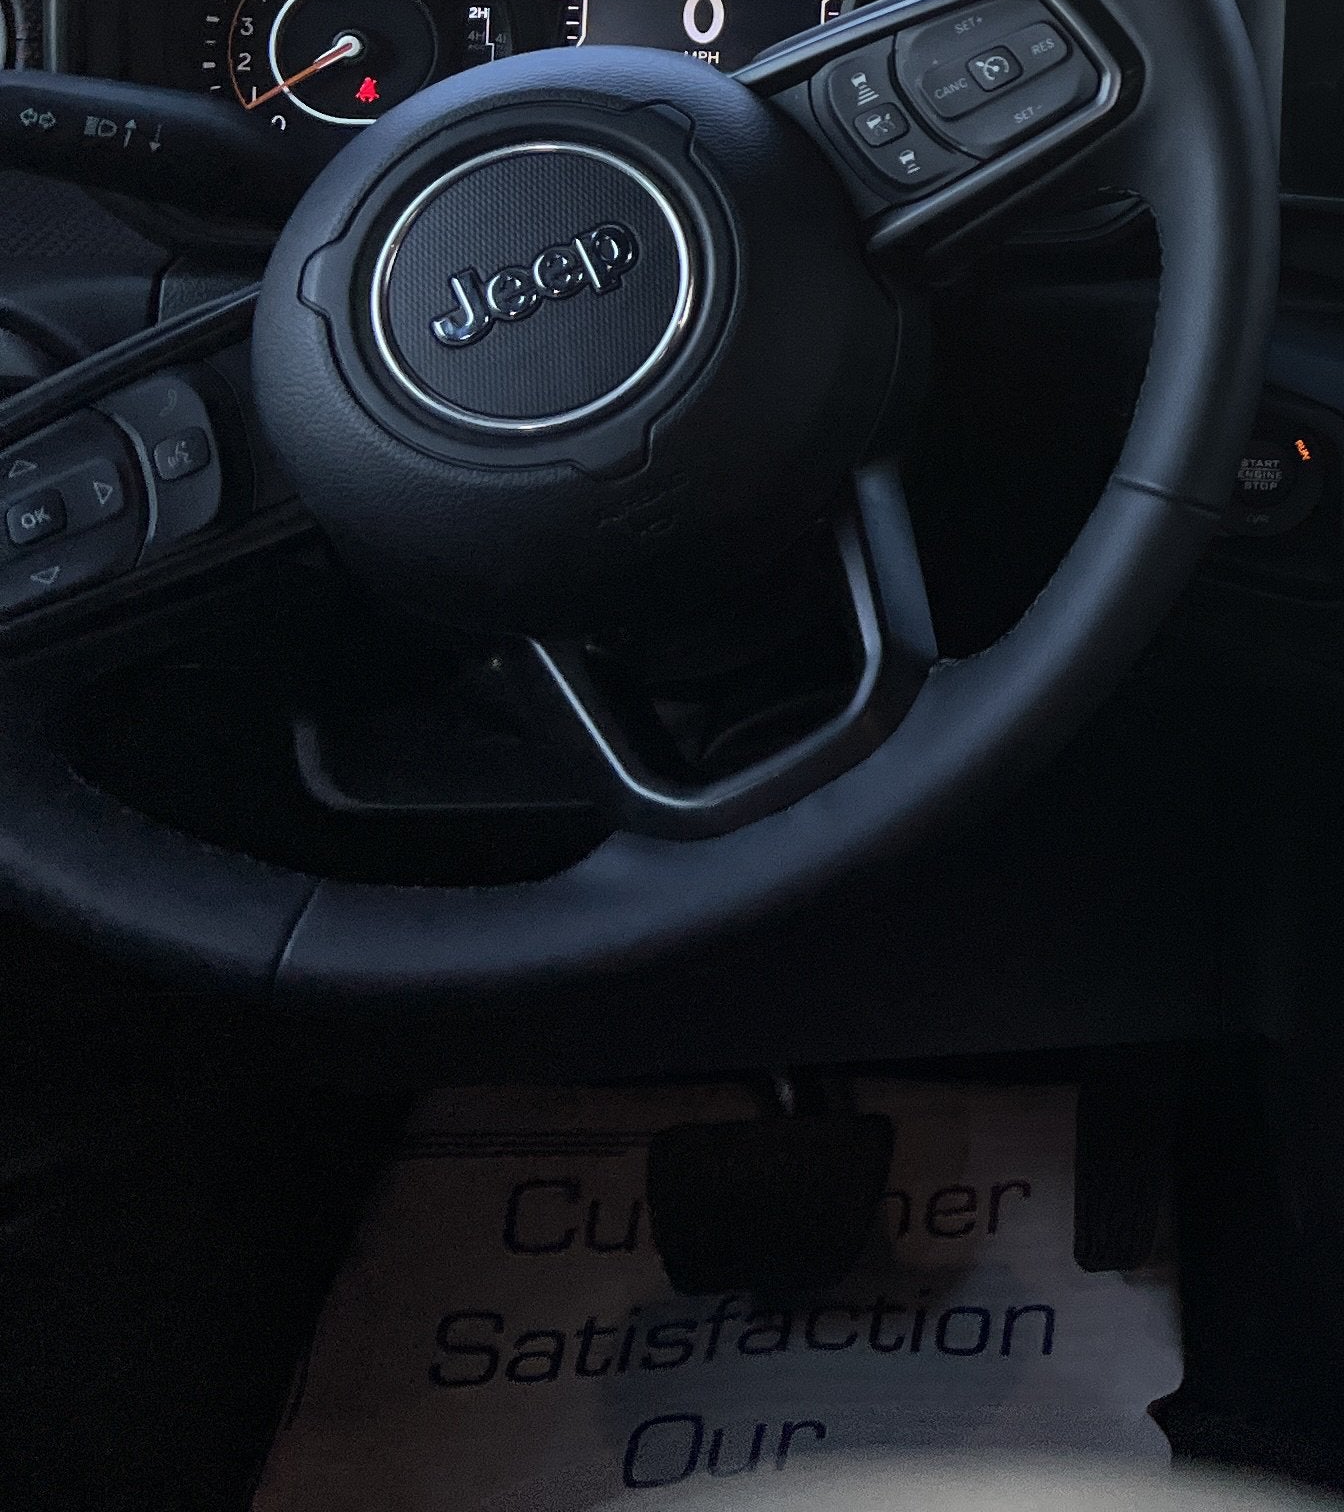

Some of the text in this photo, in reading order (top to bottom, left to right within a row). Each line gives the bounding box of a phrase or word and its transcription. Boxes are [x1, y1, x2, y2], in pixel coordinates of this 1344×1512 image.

[468, 6, 488, 19] 2H
[241, 17, 253, 36] 3
[1031, 38, 1054, 55] RES
[237, 53, 251, 71] 2
[934, 77, 968, 100] CANC
[430, 222, 637, 349] Jeep
[1241, 458, 1280, 468] START
[1238, 470, 1283, 480] ENGINE
[1244, 481, 1278, 491] STOP
[21, 506, 50, 529] OK
[428, 1288, 1055, 1388] Satisfaction
[621, 1412, 827, 1490] Our
